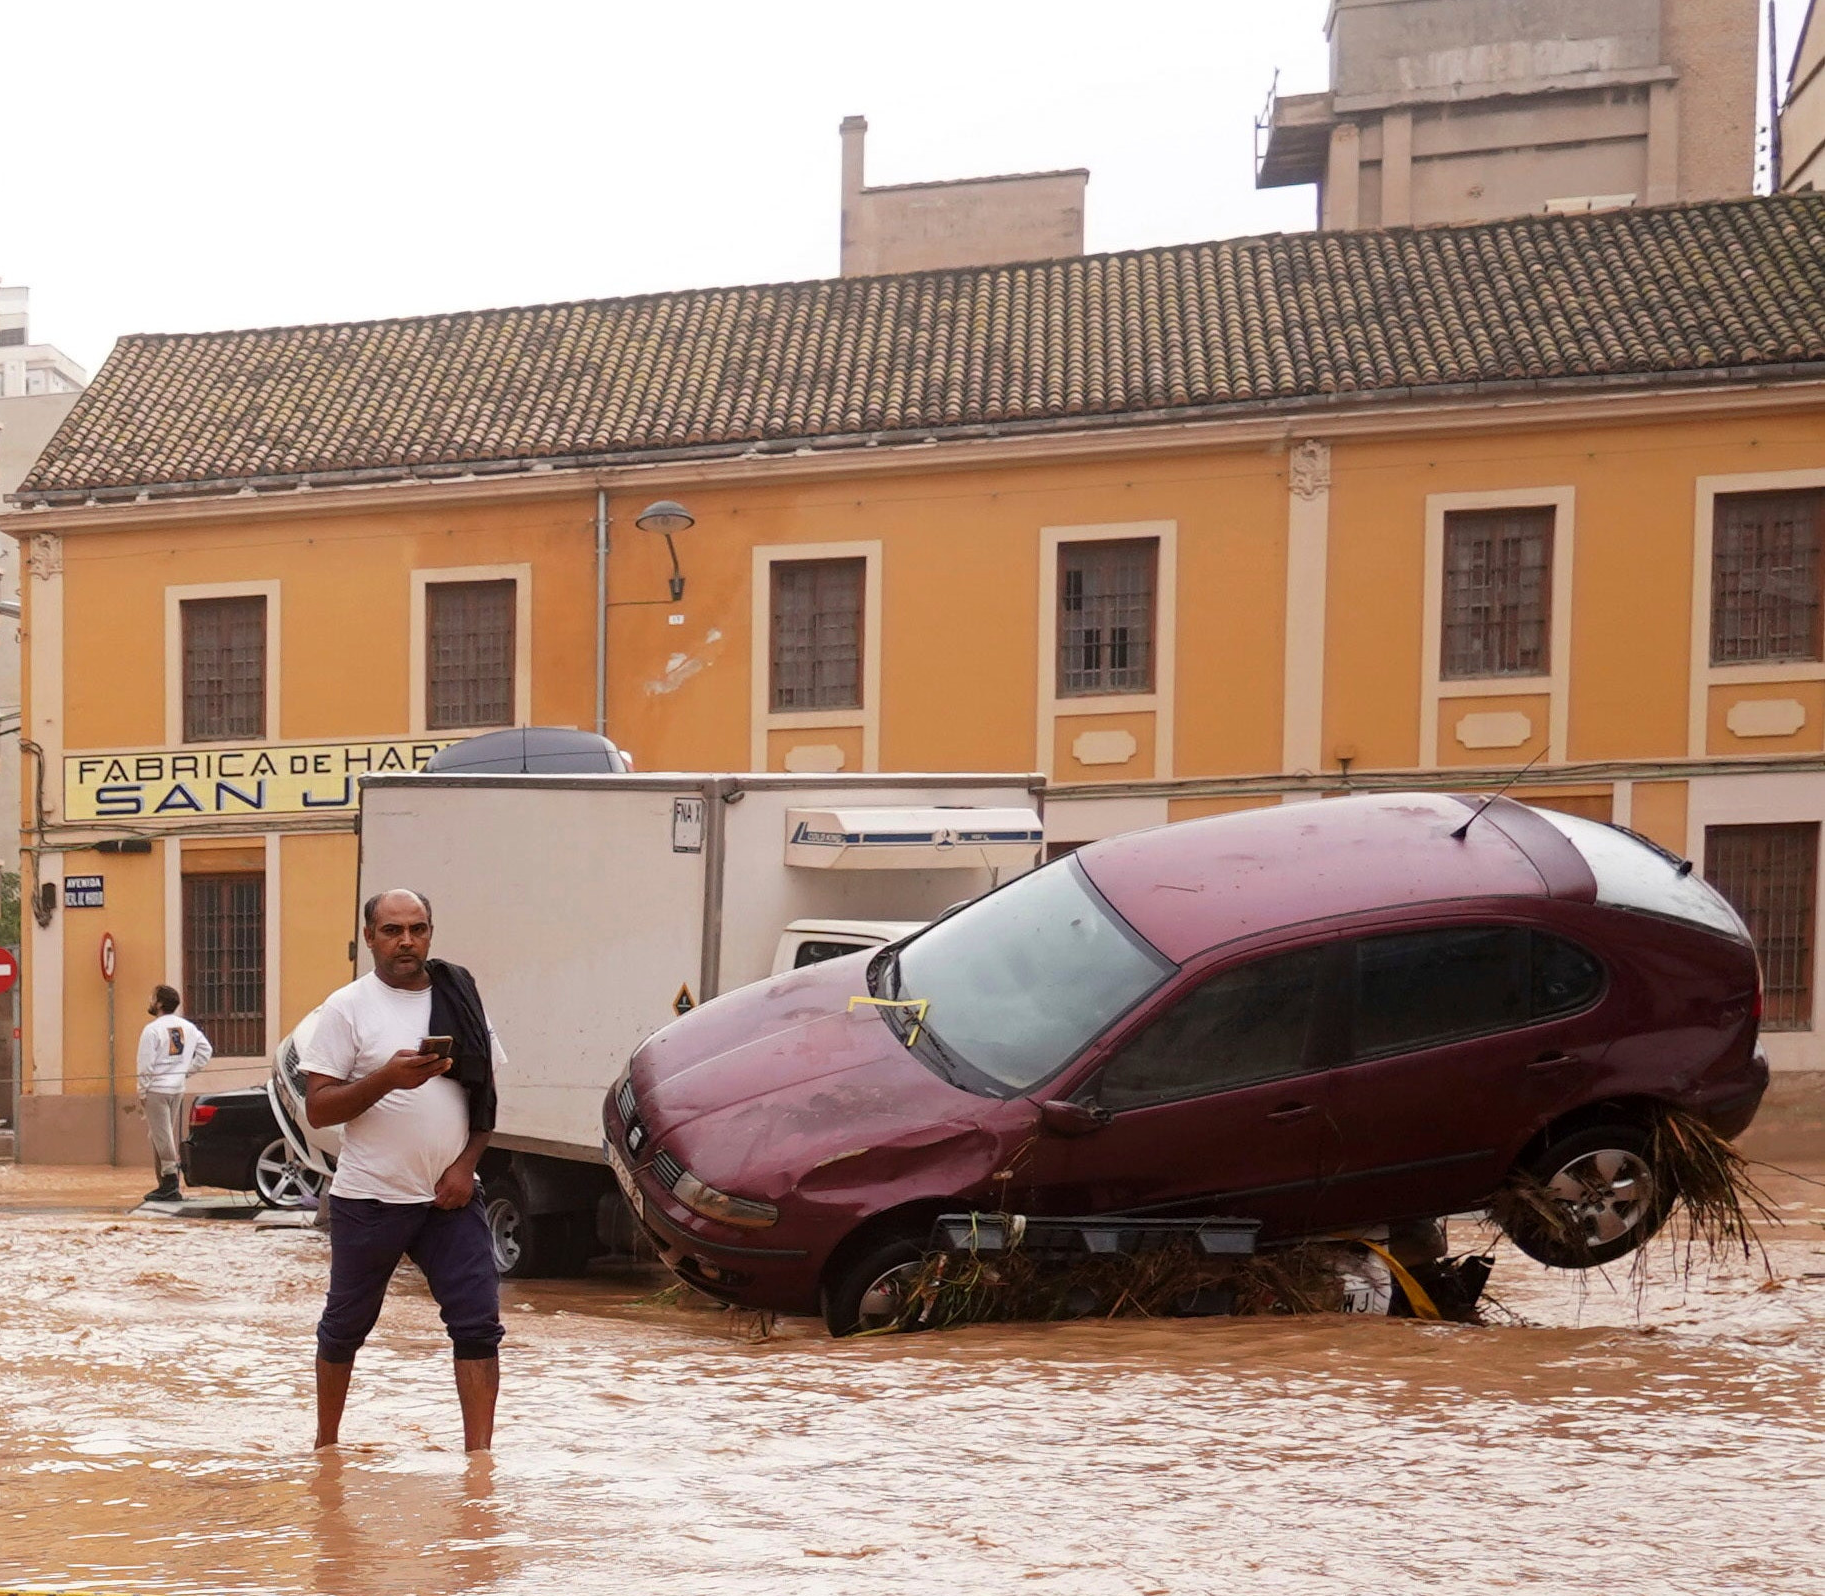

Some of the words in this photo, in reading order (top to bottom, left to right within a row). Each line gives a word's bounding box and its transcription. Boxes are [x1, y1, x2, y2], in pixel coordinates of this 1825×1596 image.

[79, 752, 277, 784] FABRICA
[290, 754, 331, 775] DE
[345, 743, 450, 773] HAR
[96, 778, 266, 816] SAN
[675, 802, 693, 823] FNA
